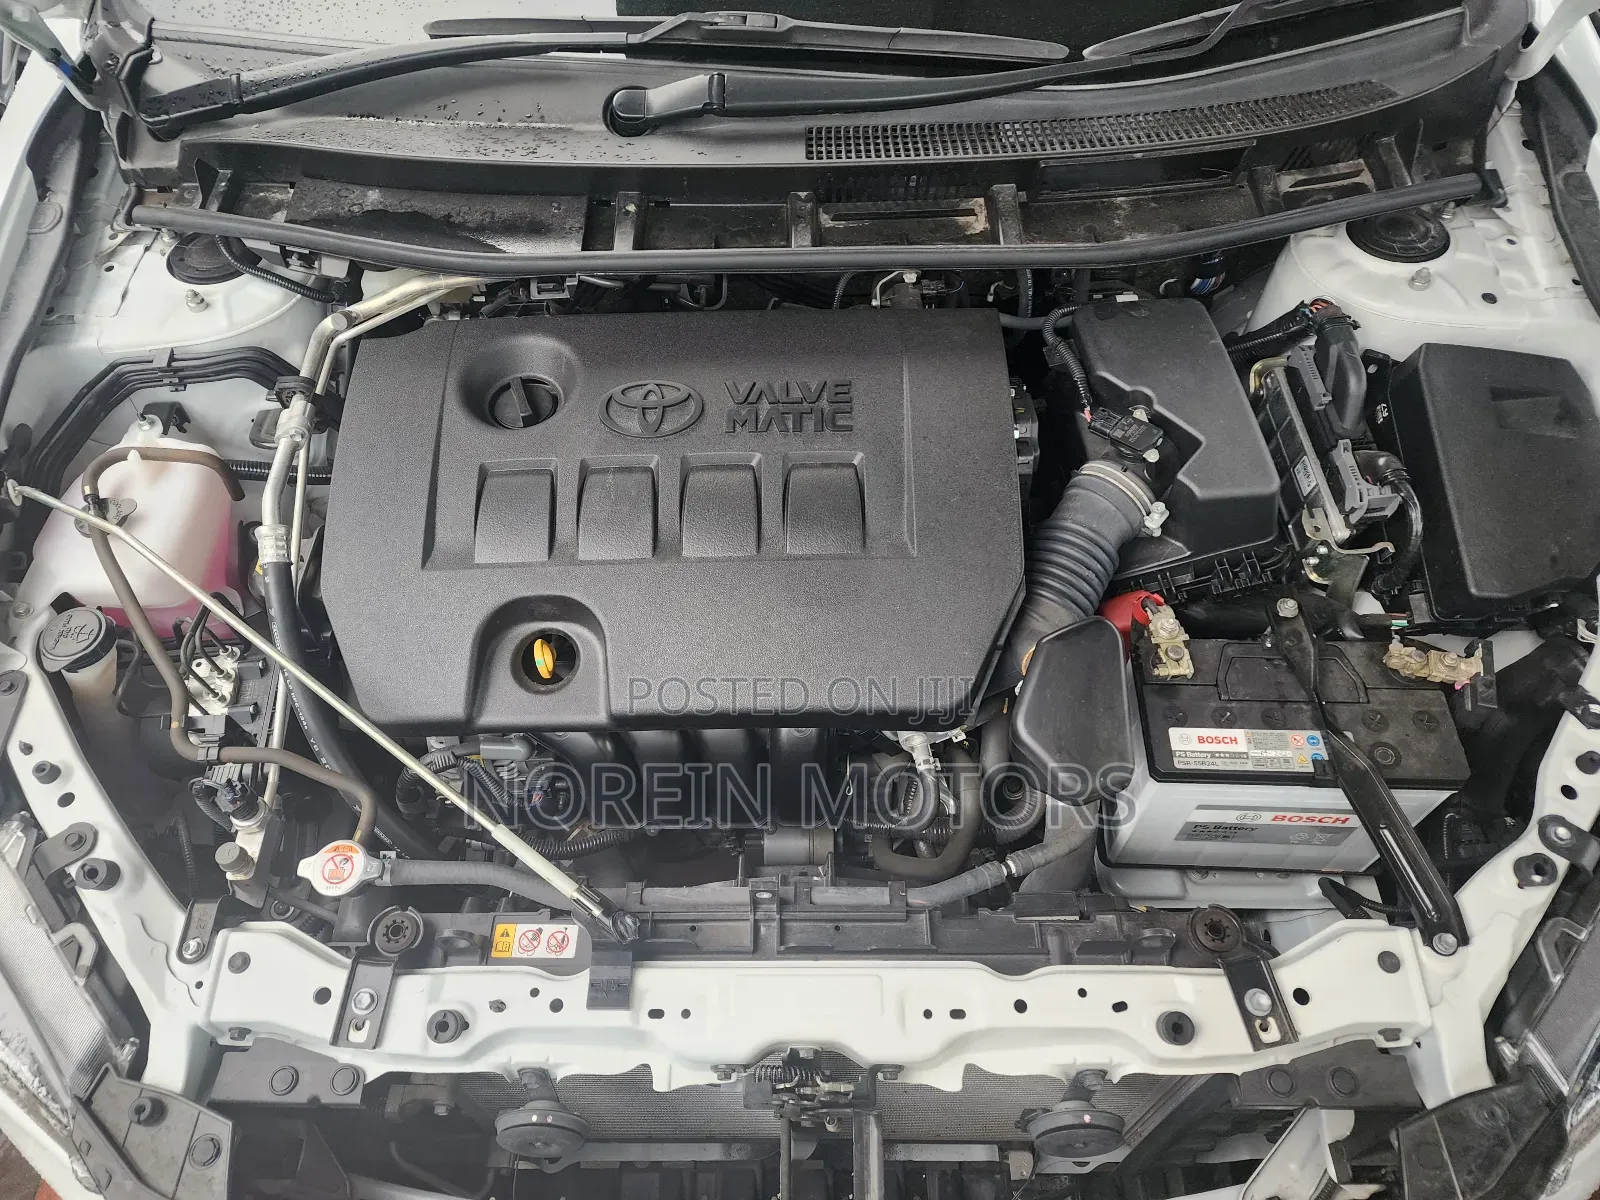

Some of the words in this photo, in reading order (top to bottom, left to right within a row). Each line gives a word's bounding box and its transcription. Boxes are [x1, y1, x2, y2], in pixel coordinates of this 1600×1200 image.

[724, 380, 852, 404] VALVE
[724, 407, 852, 433] MATIC
[1197, 735, 1238, 745] BOSCH
[1271, 814, 1350, 825] BOSCH
